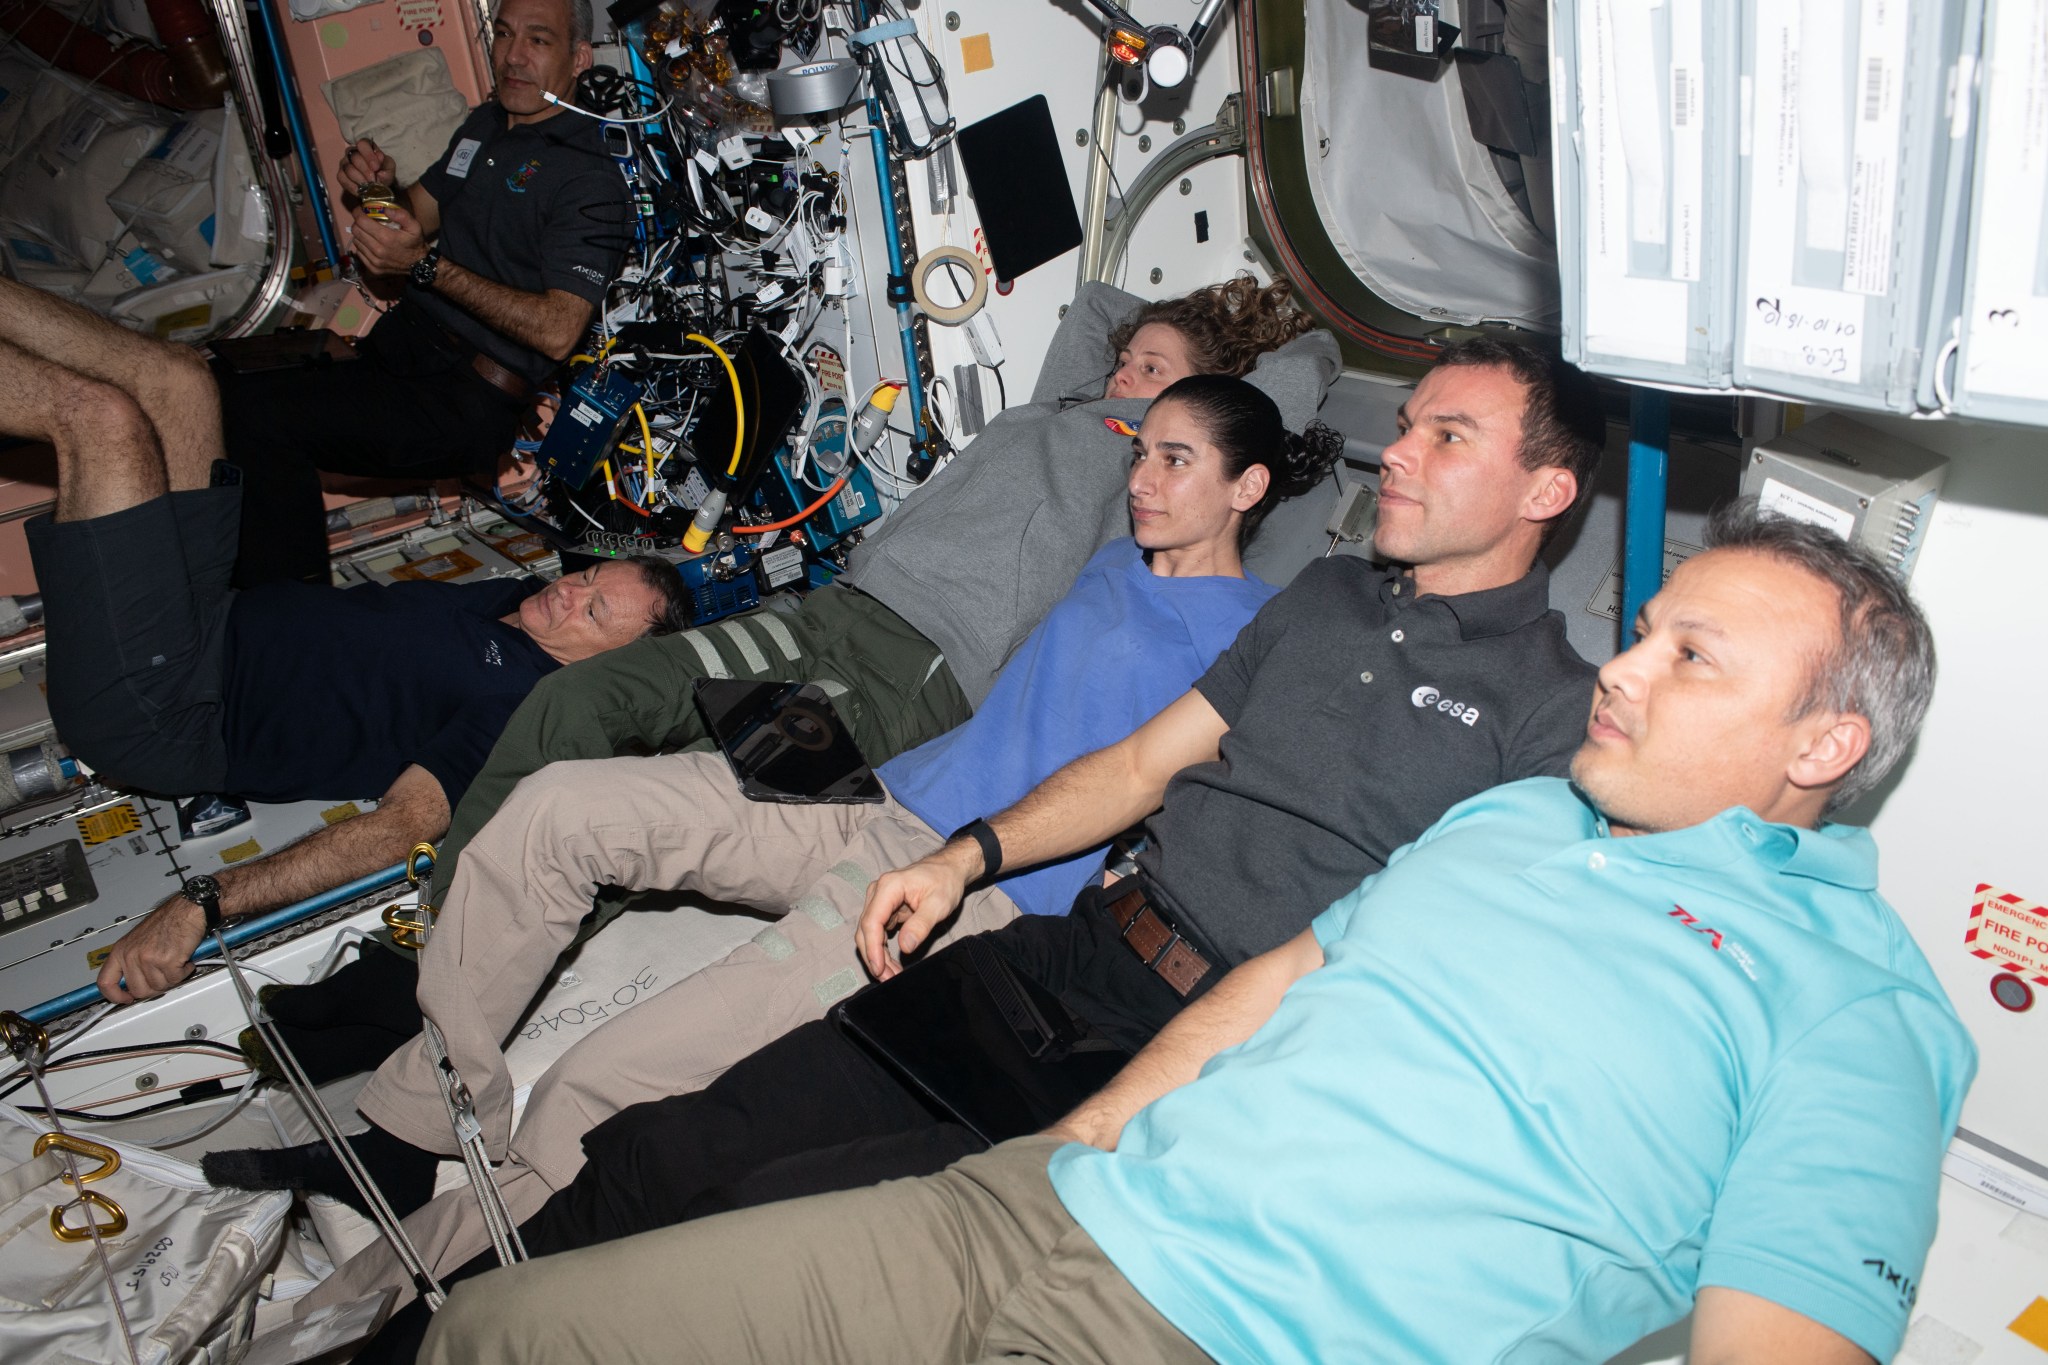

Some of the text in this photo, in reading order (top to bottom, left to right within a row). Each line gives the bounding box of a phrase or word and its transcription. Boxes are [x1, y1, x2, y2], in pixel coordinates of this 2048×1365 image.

[573, 265, 605, 278] AXIOM
[1989, 309, 2019, 327] 3
[821, 369, 844, 380] FIRE PORT
[1437, 699, 1480, 727] esa
[1984, 919, 2022, 942] FIRE
[1993, 944, 2034, 965] NOD1P1
[1863, 1258, 1917, 1306] AXIO
